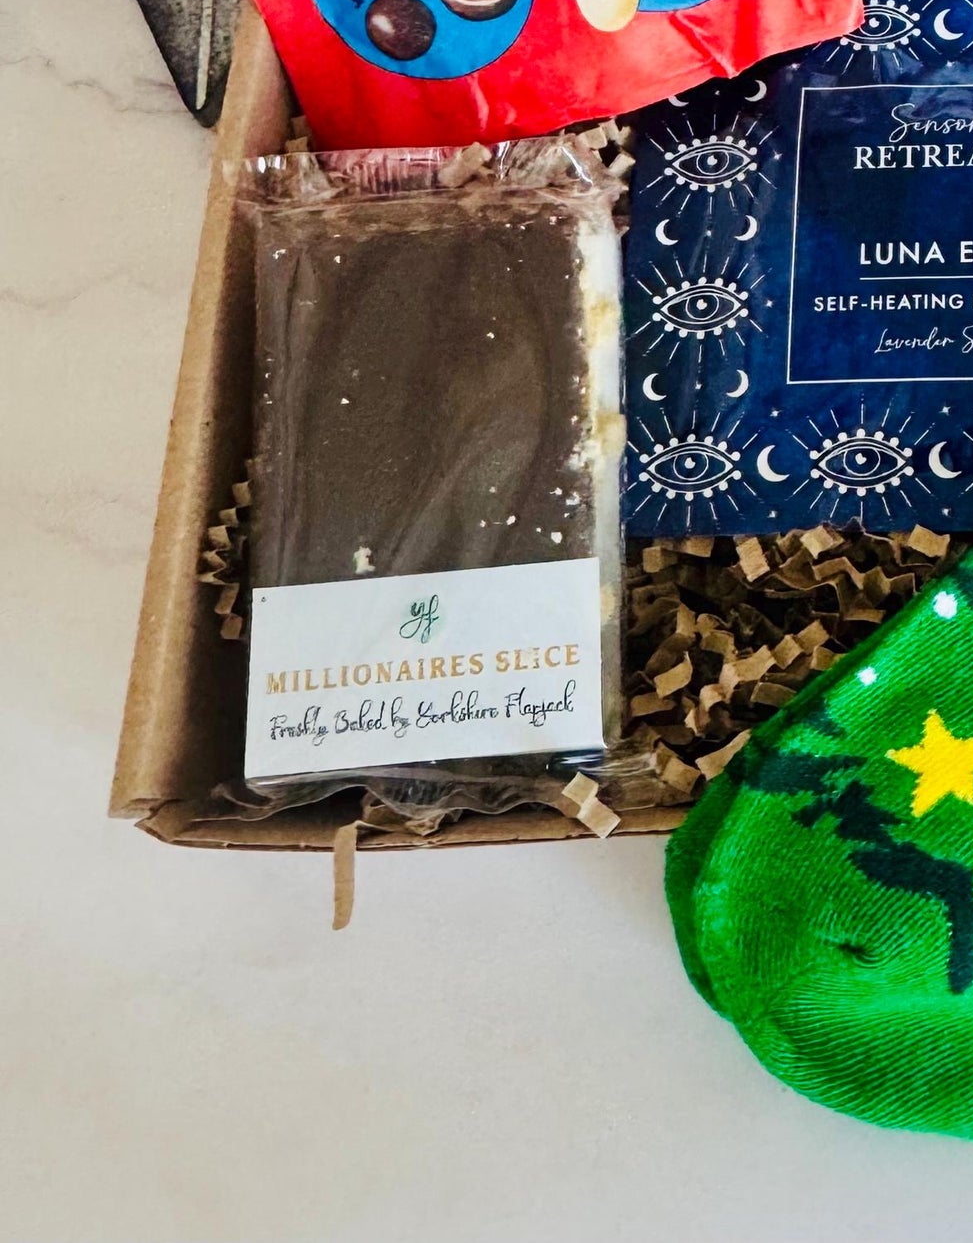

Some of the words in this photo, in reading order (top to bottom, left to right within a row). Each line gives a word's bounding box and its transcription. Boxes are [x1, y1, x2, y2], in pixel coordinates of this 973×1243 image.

[859, 241, 945, 265] LUNA
[814, 293, 965, 312] SELF-HEATING
[874, 325, 955, 354] Lavender
[265, 652, 484, 695] MILLIONAIRES
[495, 644, 581, 672] SLICE
[504, 679, 577, 728] Flapjack
